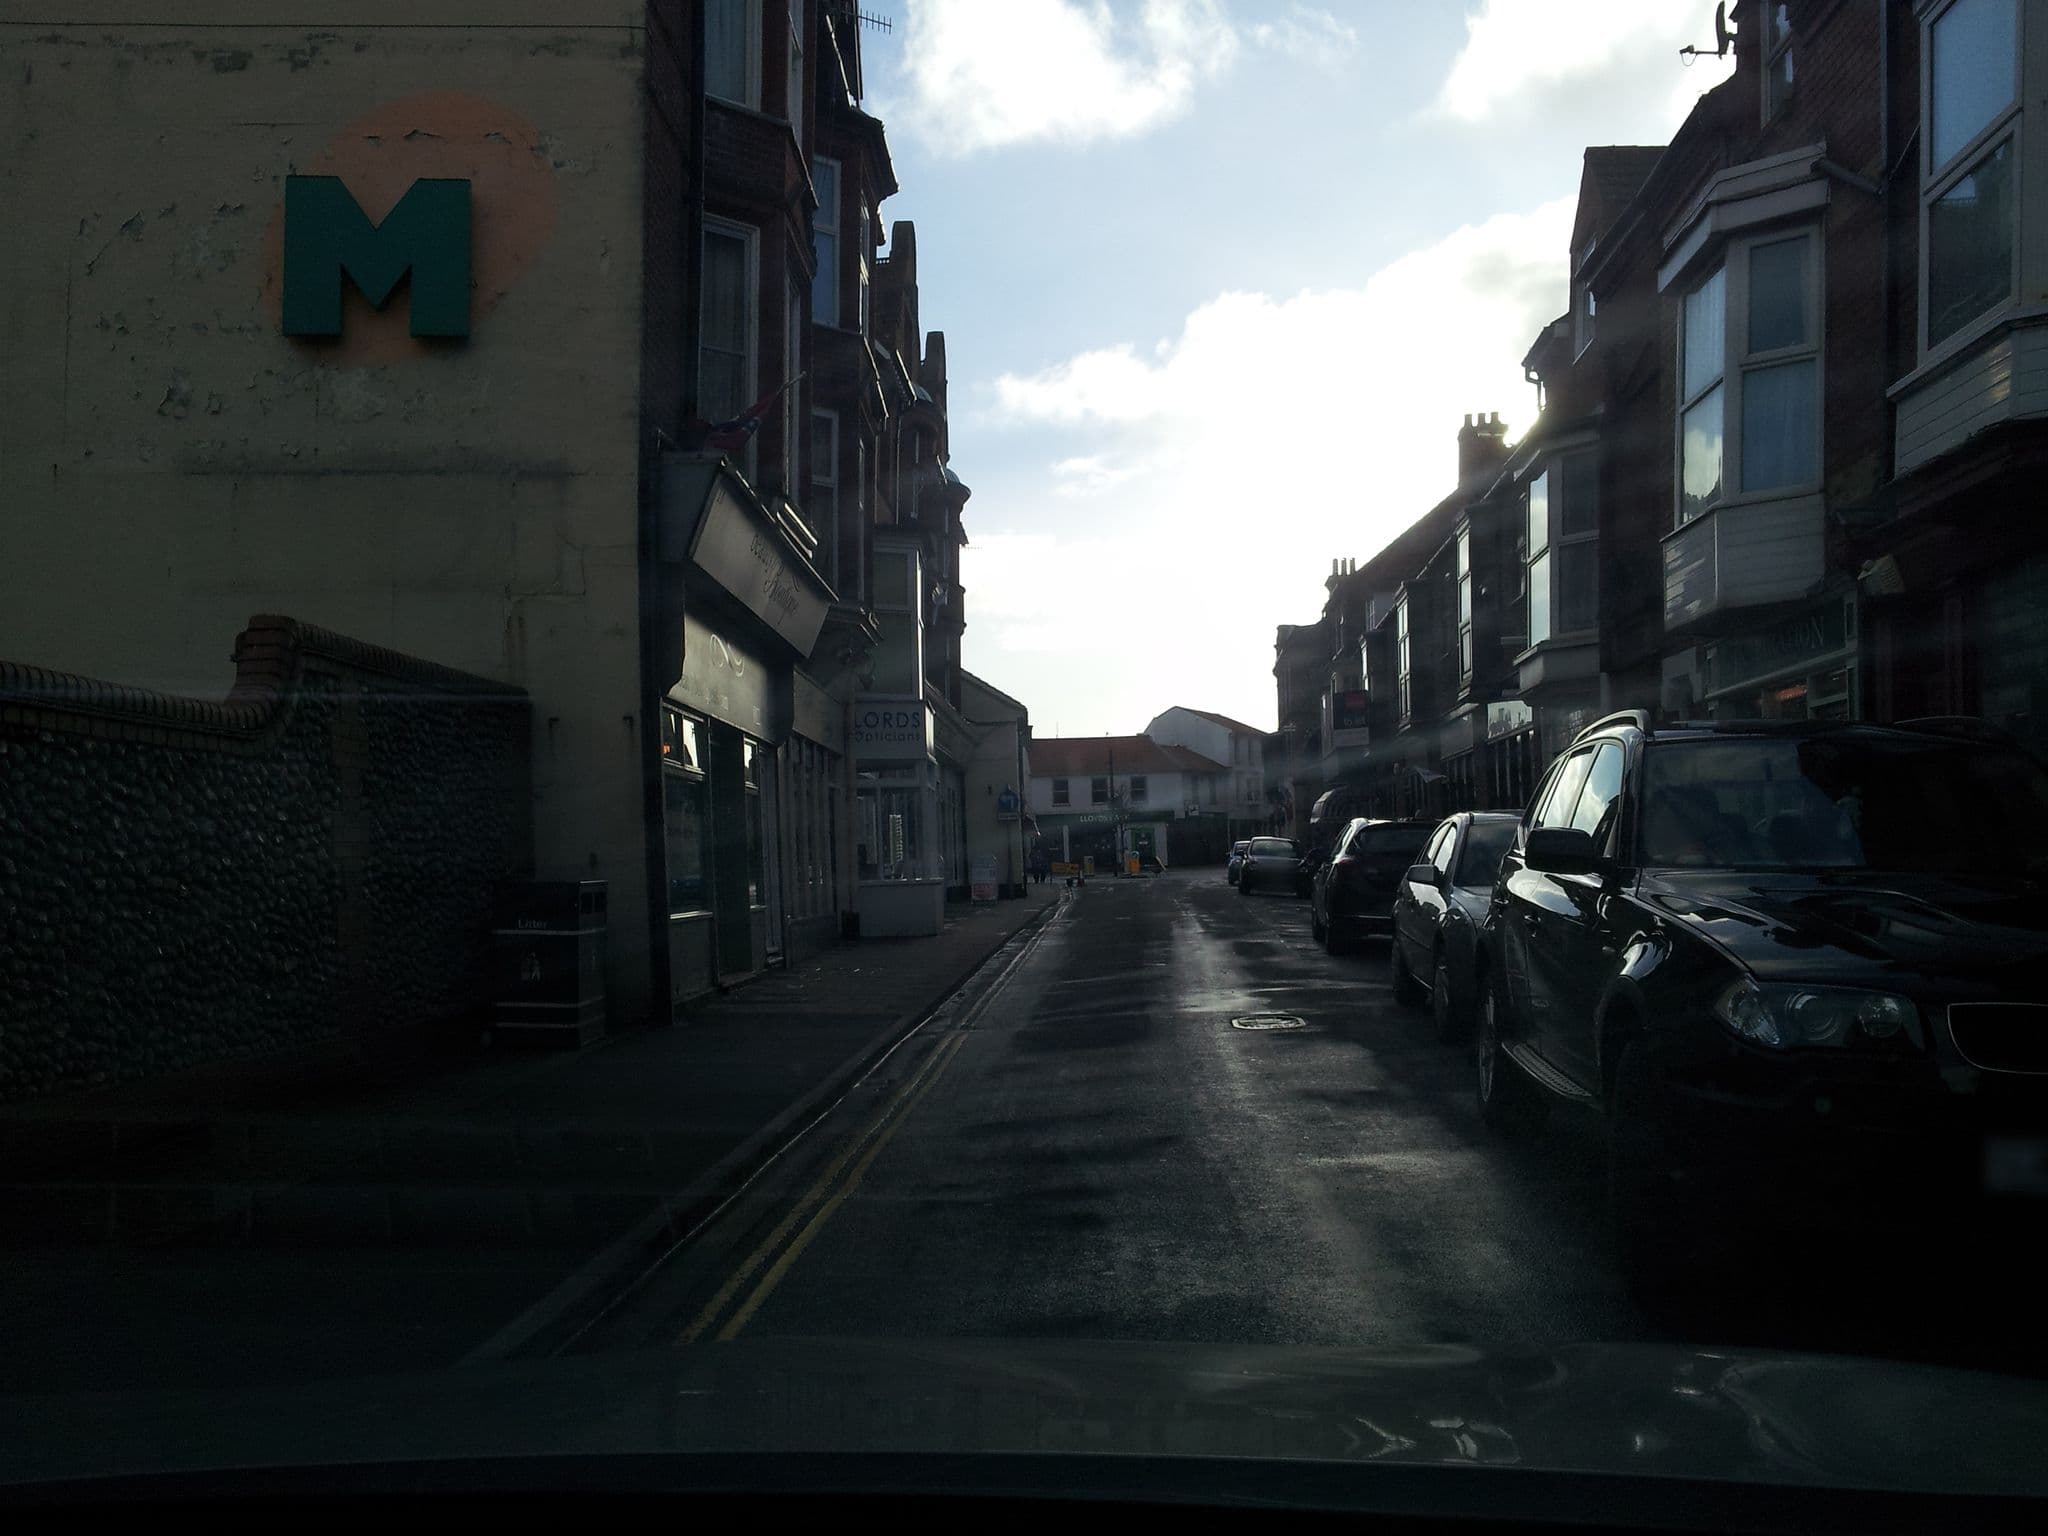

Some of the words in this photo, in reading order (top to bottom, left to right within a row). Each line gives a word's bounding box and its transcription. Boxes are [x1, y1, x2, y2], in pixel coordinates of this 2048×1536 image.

[283, 176, 470, 338] M
[854, 711, 921, 729] LORDS
[855, 730, 921, 743] Opticians
